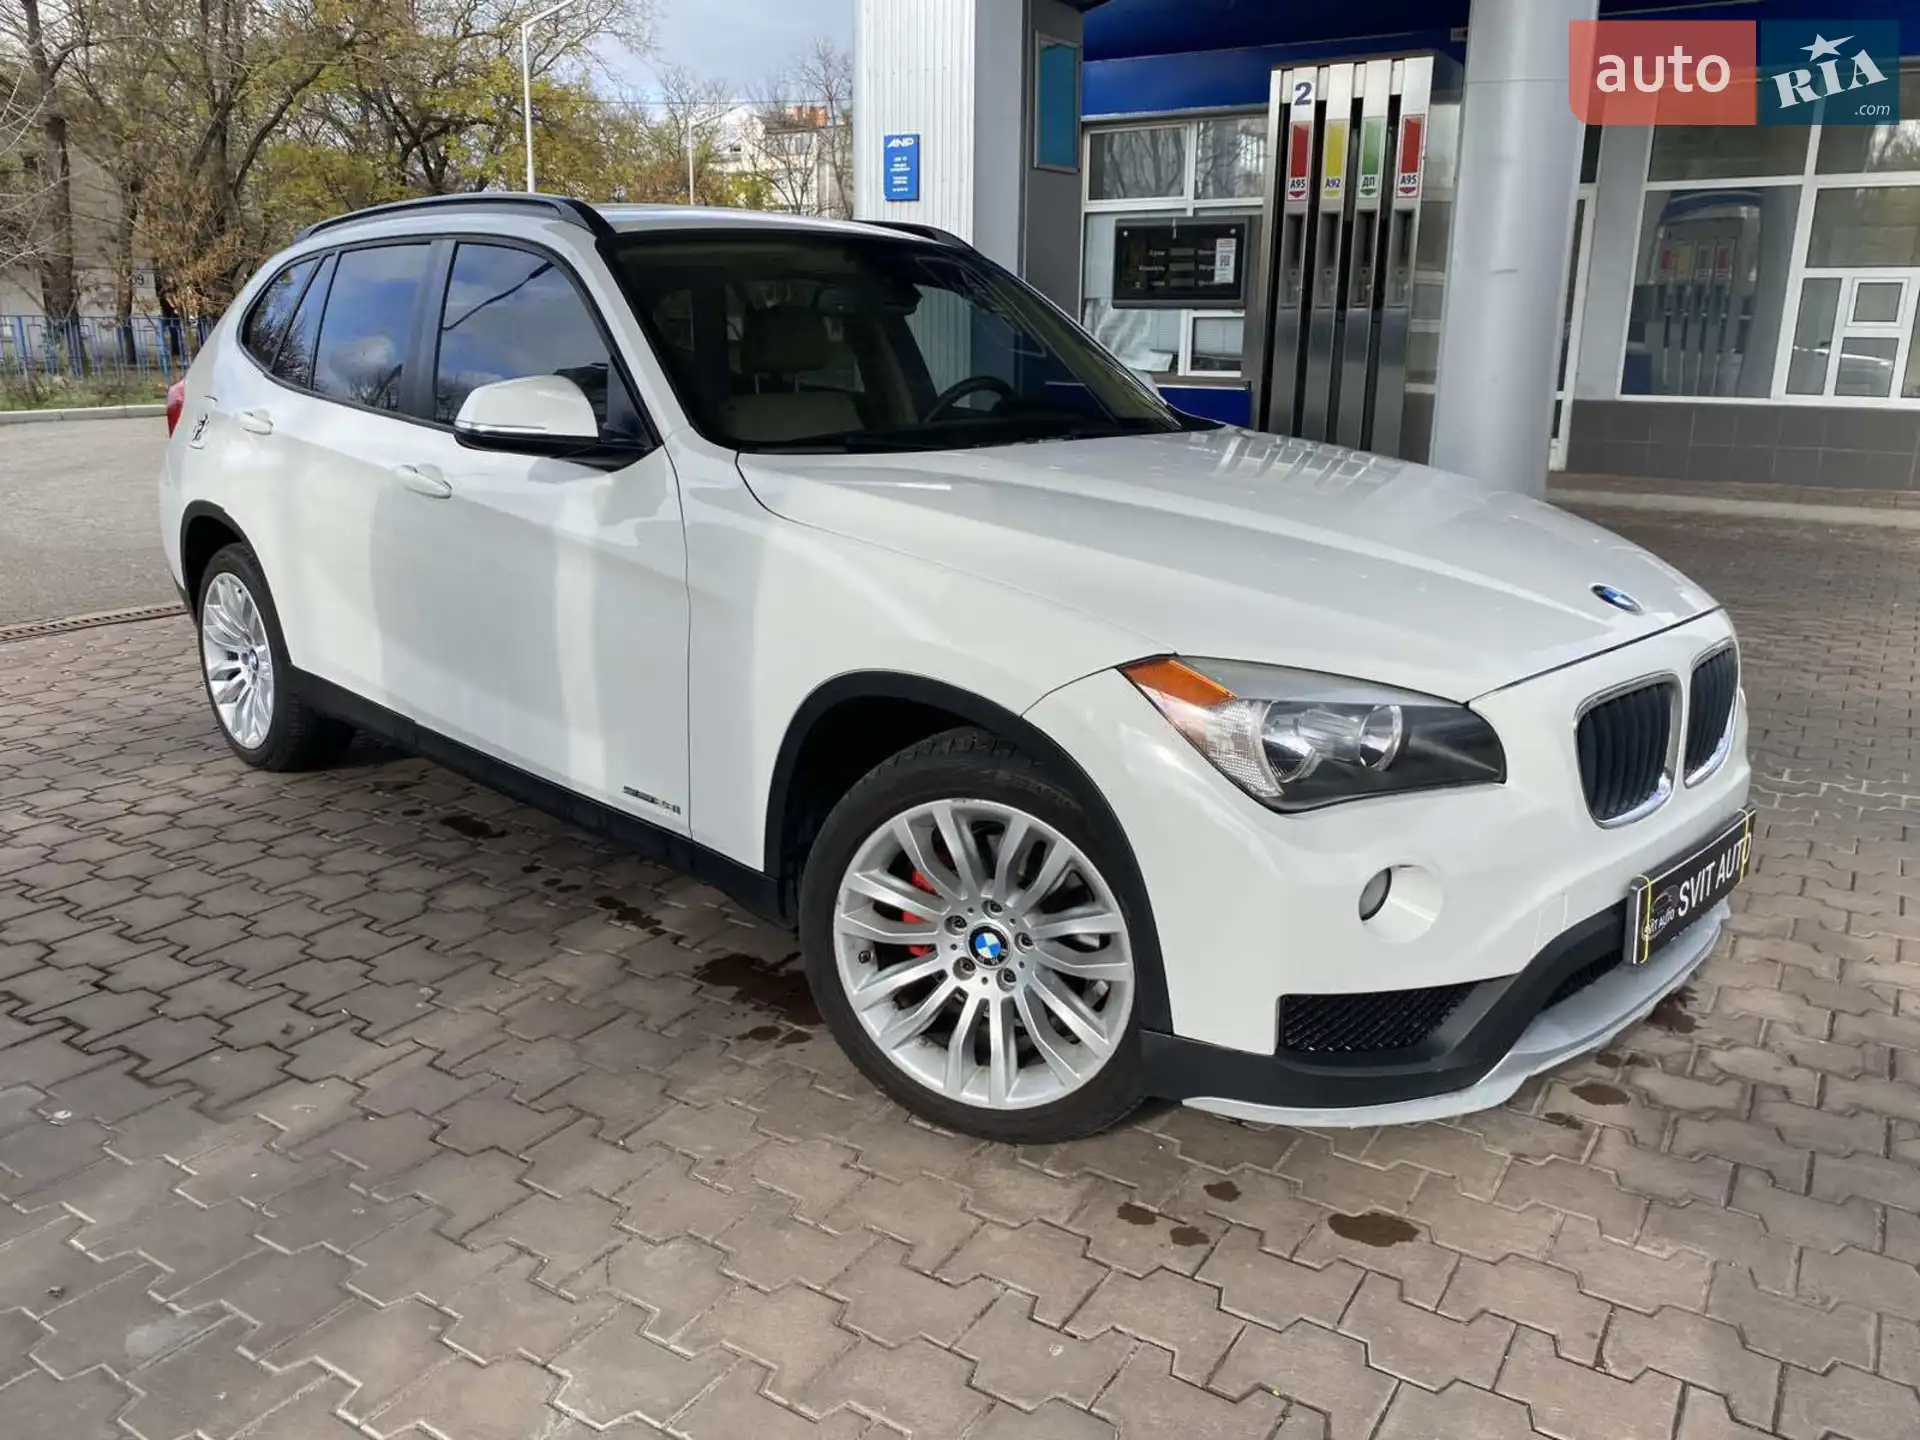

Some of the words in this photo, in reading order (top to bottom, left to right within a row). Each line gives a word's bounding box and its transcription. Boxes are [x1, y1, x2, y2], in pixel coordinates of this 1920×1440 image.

[1294, 81, 1313, 106] 2
[1678, 861, 1716, 917] SVIT
[1715, 832, 1752, 890] AUTO
